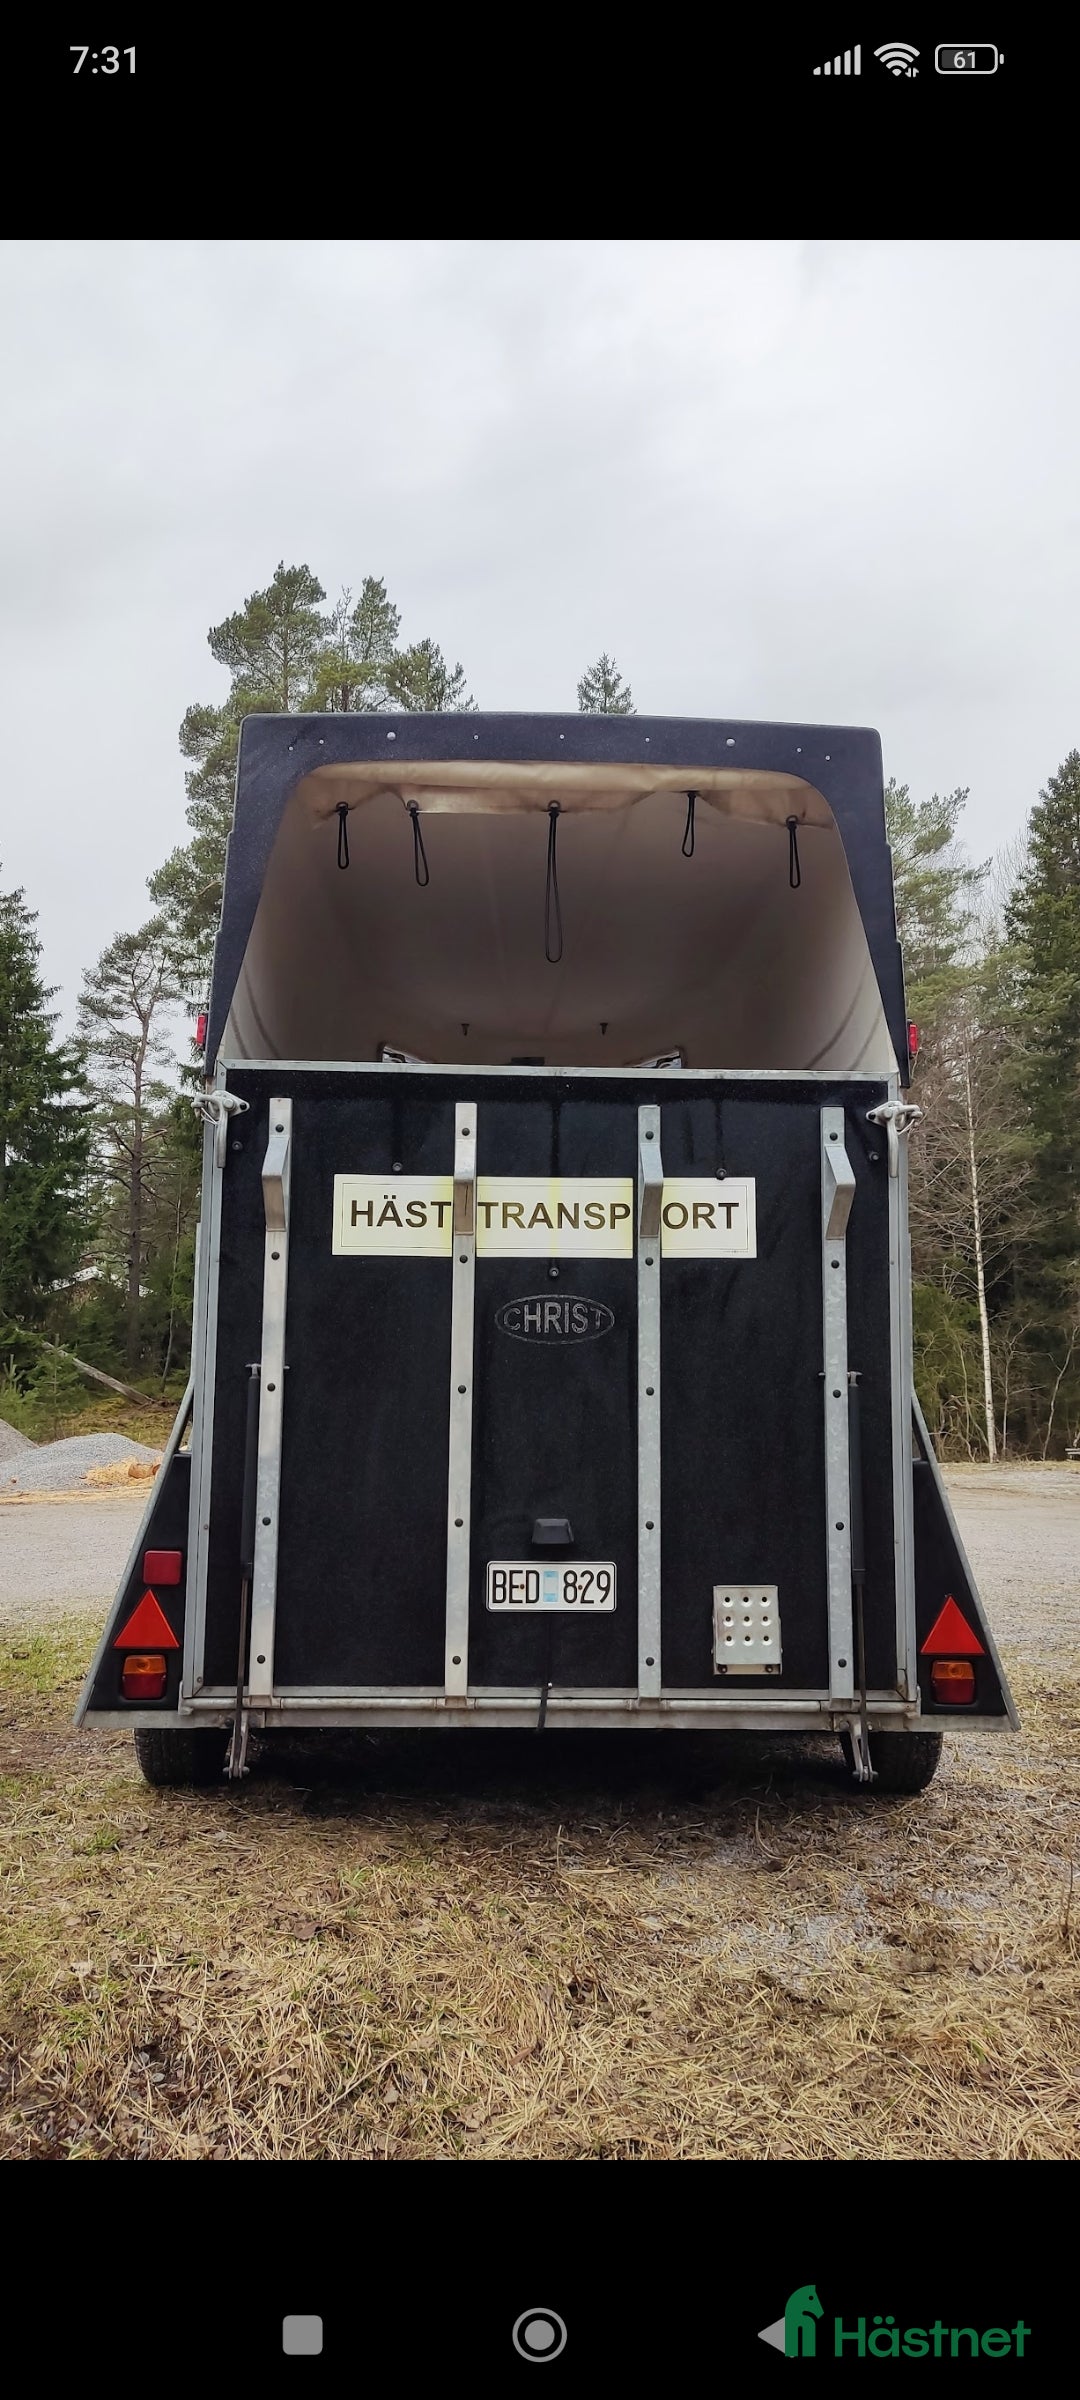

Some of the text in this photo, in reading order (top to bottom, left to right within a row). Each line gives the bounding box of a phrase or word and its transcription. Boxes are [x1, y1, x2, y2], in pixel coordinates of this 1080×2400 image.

[503, 1301, 607, 1334] CHRIST
[492, 1569, 611, 1604] BED 829
